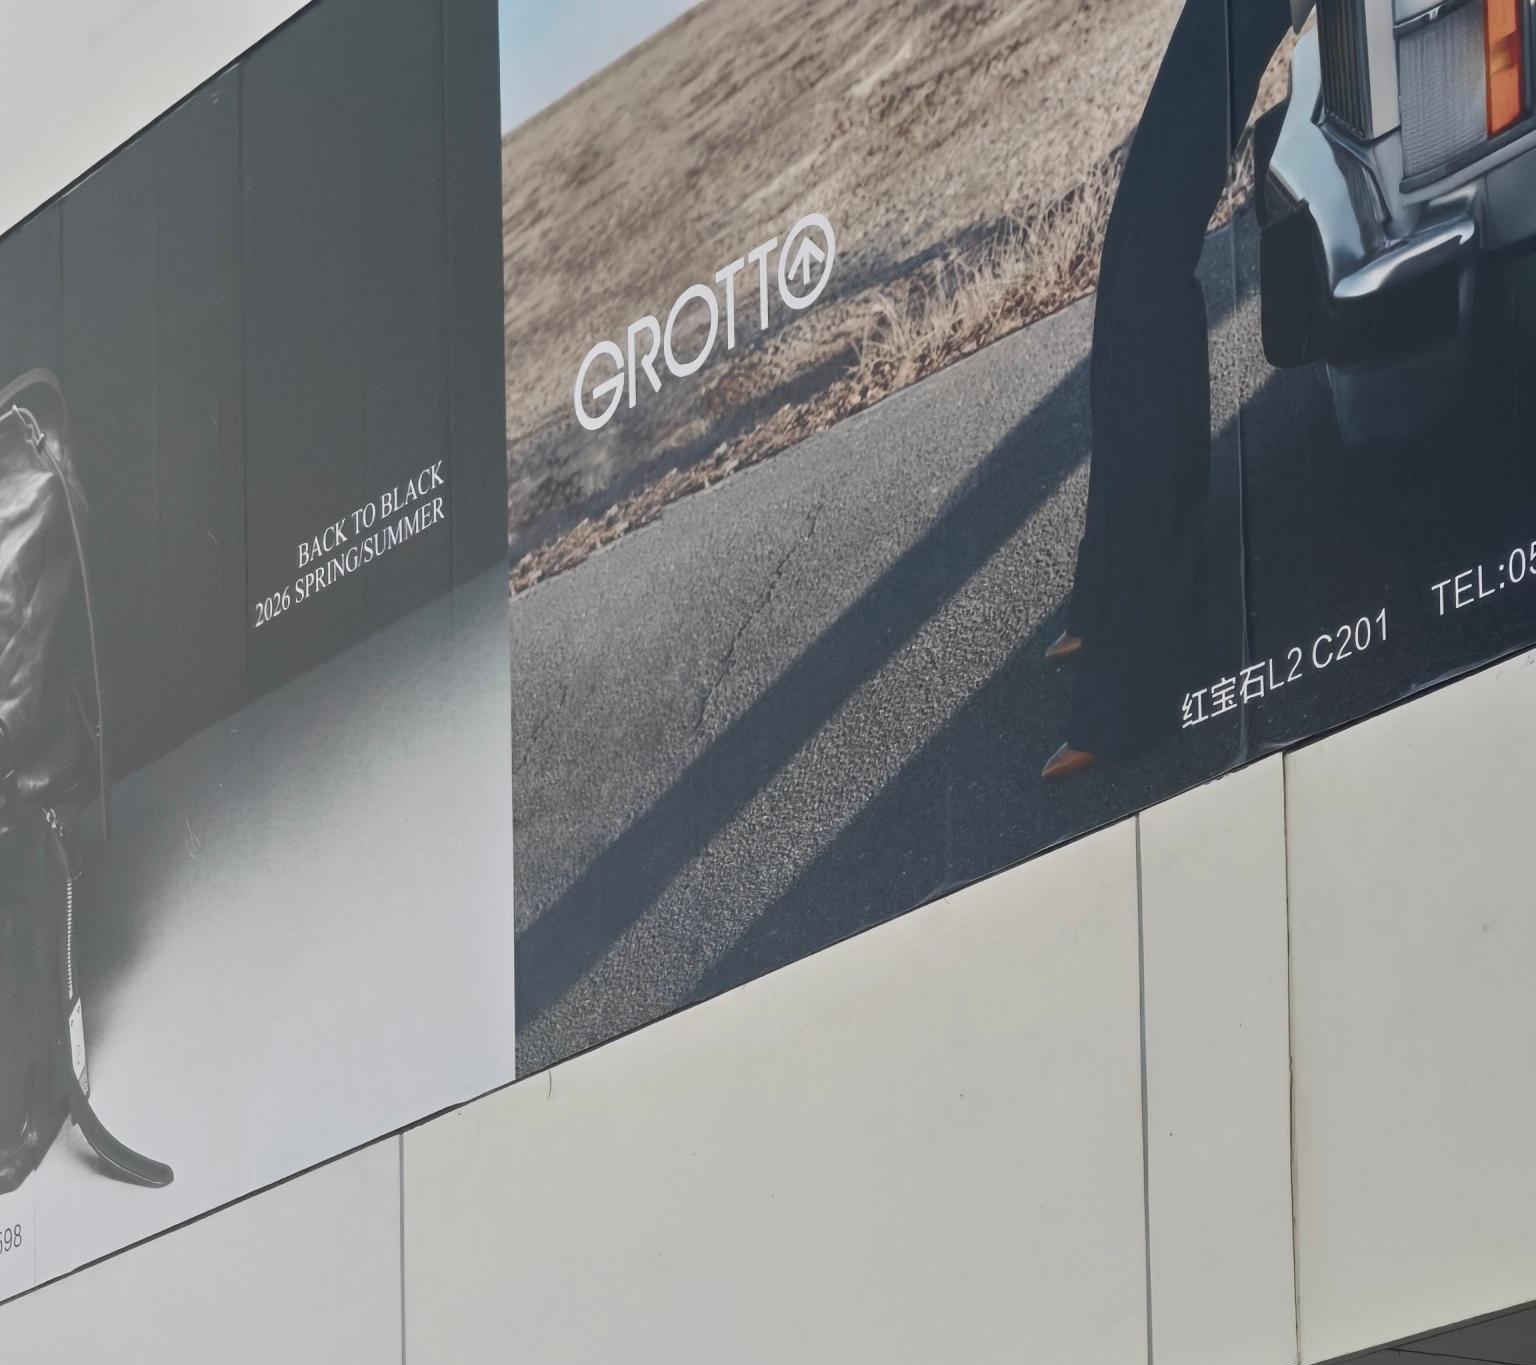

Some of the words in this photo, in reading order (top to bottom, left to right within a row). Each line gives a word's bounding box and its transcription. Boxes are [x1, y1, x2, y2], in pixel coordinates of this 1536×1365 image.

[574, 213, 836, 431] GROTTO
[254, 586, 291, 628] 2026
[295, 497, 445, 603] SPRING/SUMMER
[298, 519, 348, 568] BACK
[351, 502, 376, 534] TO
[381, 459, 445, 519] BLACK
[1181, 646, 1303, 729] 红宝石L2
[1312, 607, 1387, 669] C201
